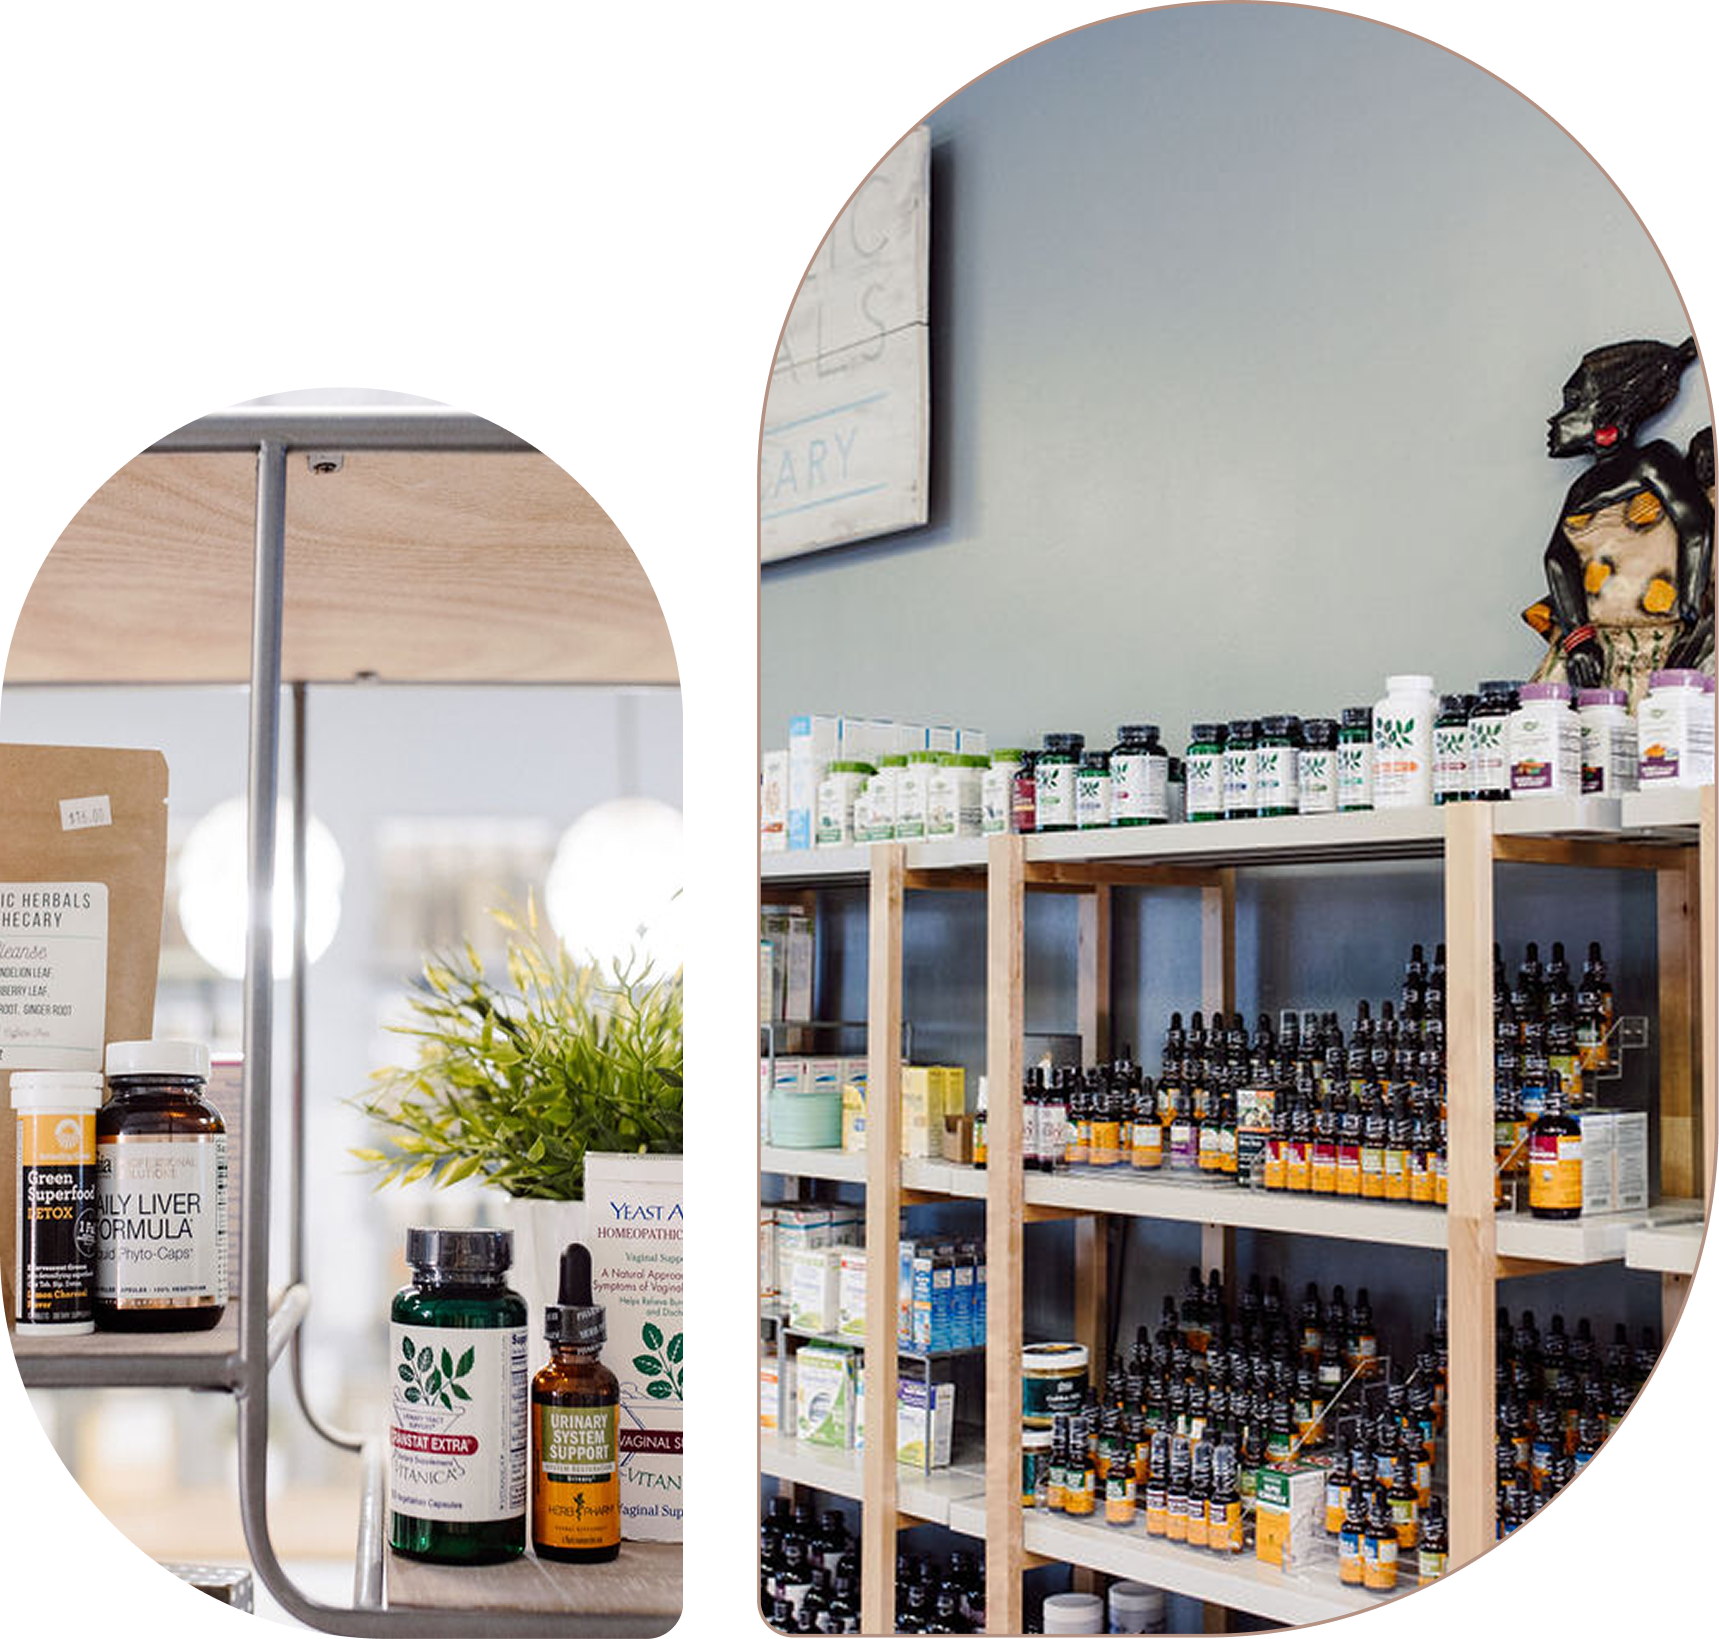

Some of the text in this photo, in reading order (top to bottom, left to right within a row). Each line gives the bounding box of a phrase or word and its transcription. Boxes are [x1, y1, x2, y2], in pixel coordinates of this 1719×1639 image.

[22, 892, 91, 909] HERBALS
[28, 1169, 74, 1186] Green
[139, 1193, 201, 1215] LIVER
[610, 1201, 664, 1221] YEAST
[28, 1206, 74, 1221] DETOX
[597, 1227, 683, 1241] HOMEOPATHIC
[611, 1268, 645, 1279] Natural
[594, 1279, 637, 1293] Symptoms
[550, 1413, 608, 1430] URINARY
[430, 1437, 469, 1453] EXTRA
[553, 1429, 606, 1446] SYSTEM
[549, 1444, 610, 1461] SUPPORT
